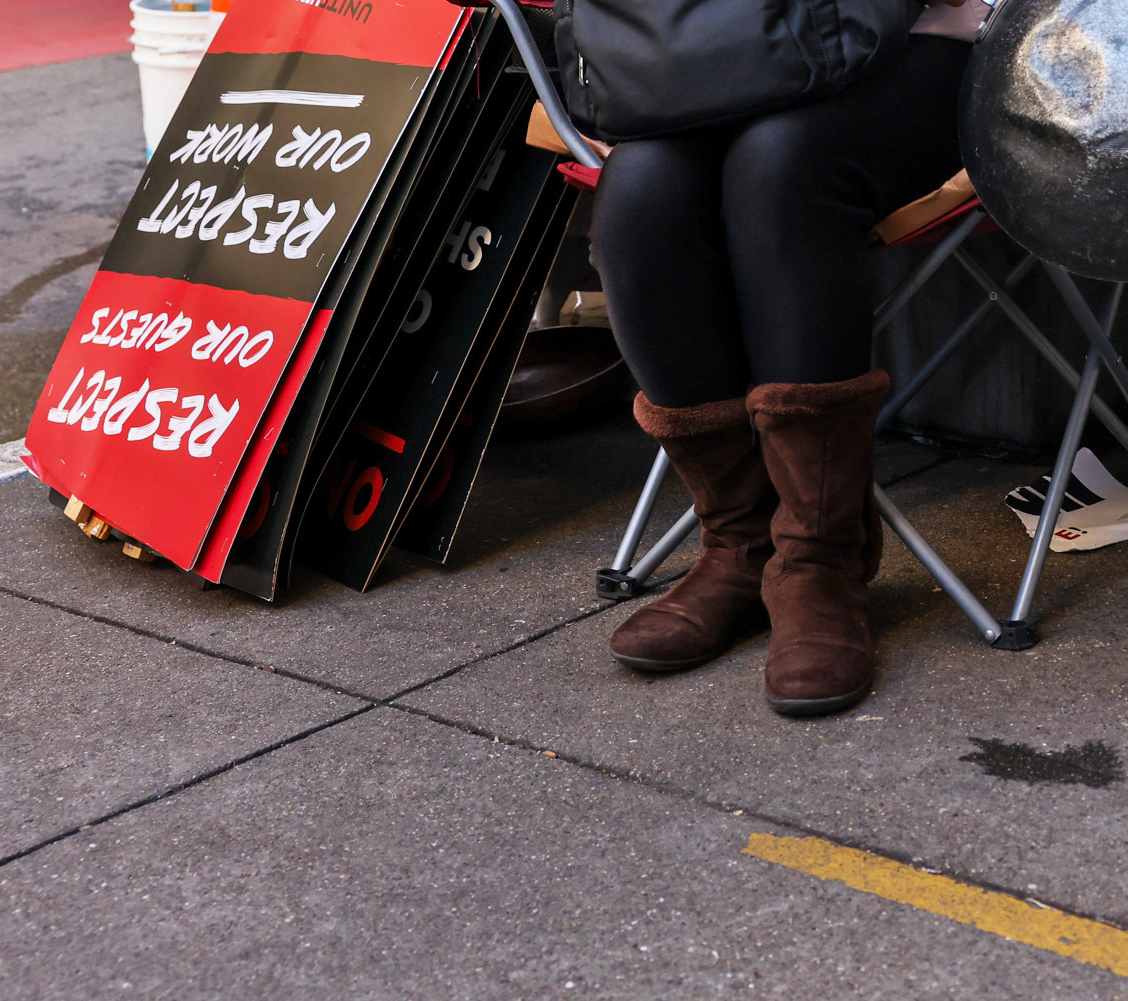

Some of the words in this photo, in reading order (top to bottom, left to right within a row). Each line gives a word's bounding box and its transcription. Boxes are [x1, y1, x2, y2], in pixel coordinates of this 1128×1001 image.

[170, 123, 274, 165] WORK
[275, 124, 372, 173] OUR
[137, 179, 337, 260] RESPECT
[80, 307, 193, 352] GUESTS
[191, 319, 274, 368] OUR
[47, 366, 240, 458] RESPECT
